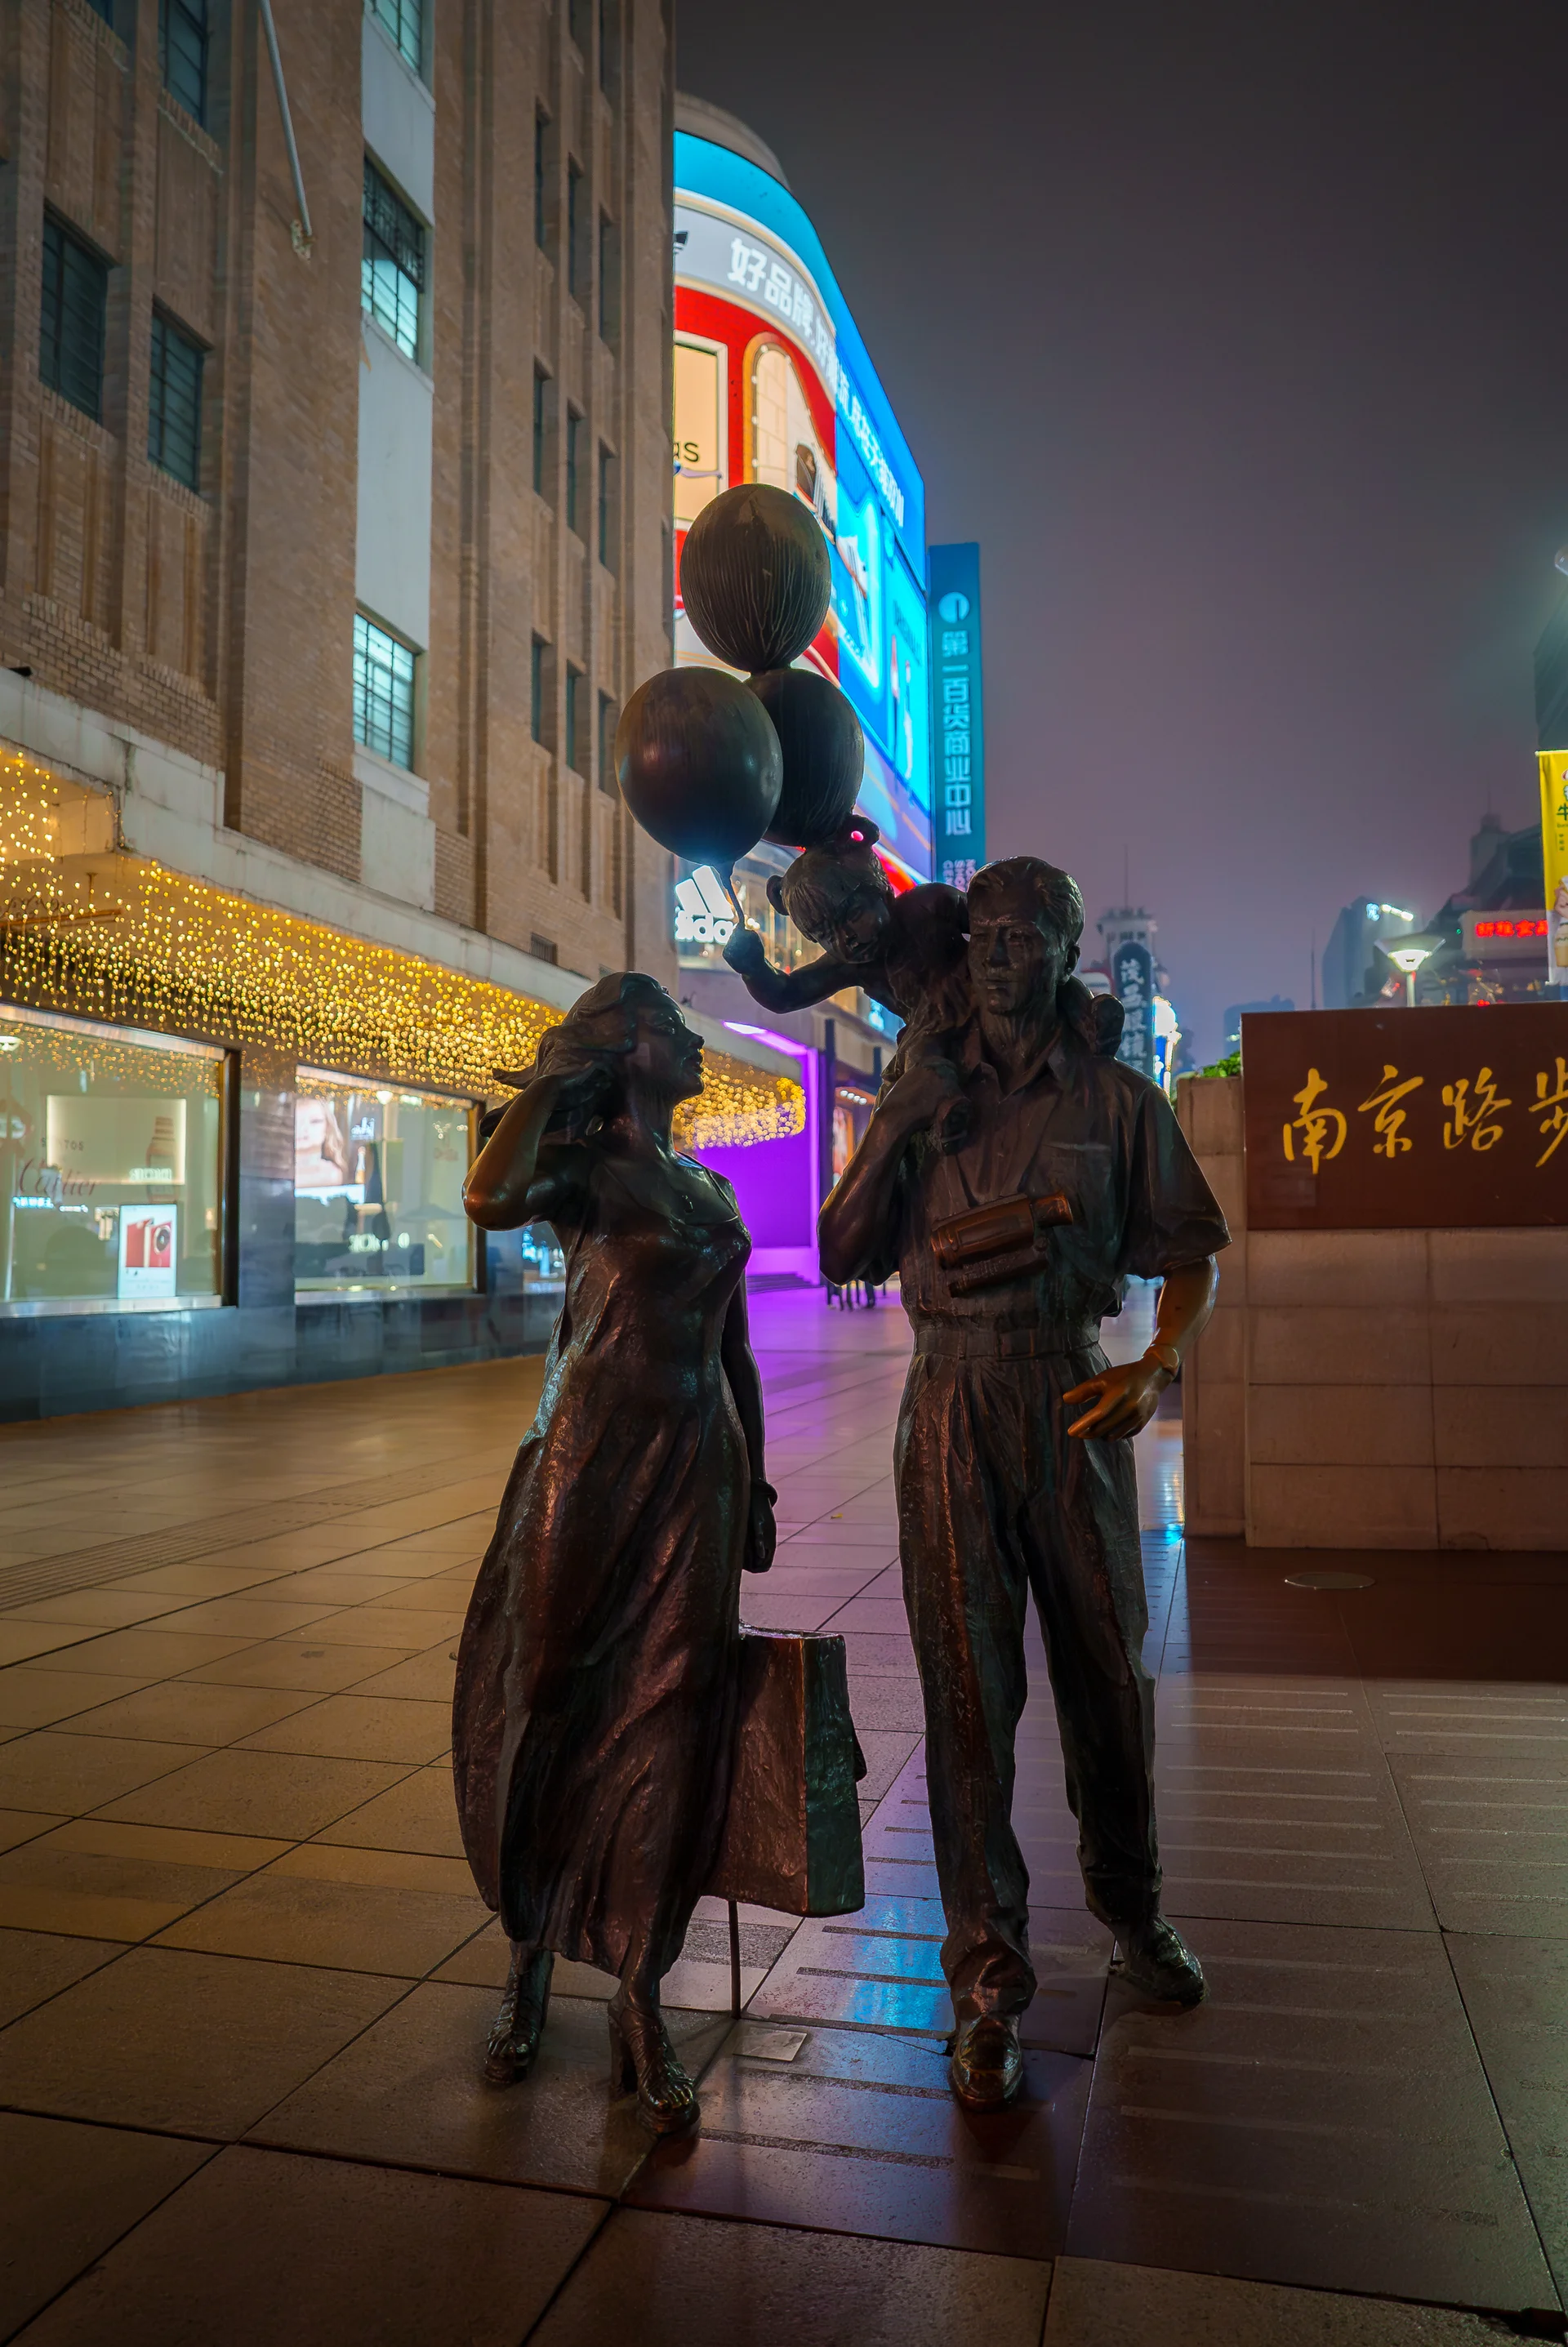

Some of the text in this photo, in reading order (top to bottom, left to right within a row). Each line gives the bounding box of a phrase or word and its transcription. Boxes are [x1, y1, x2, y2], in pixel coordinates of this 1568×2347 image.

[942, 630, 972, 837] 第一百货商业中心
[20, 1158, 100, 1195] Cartier
